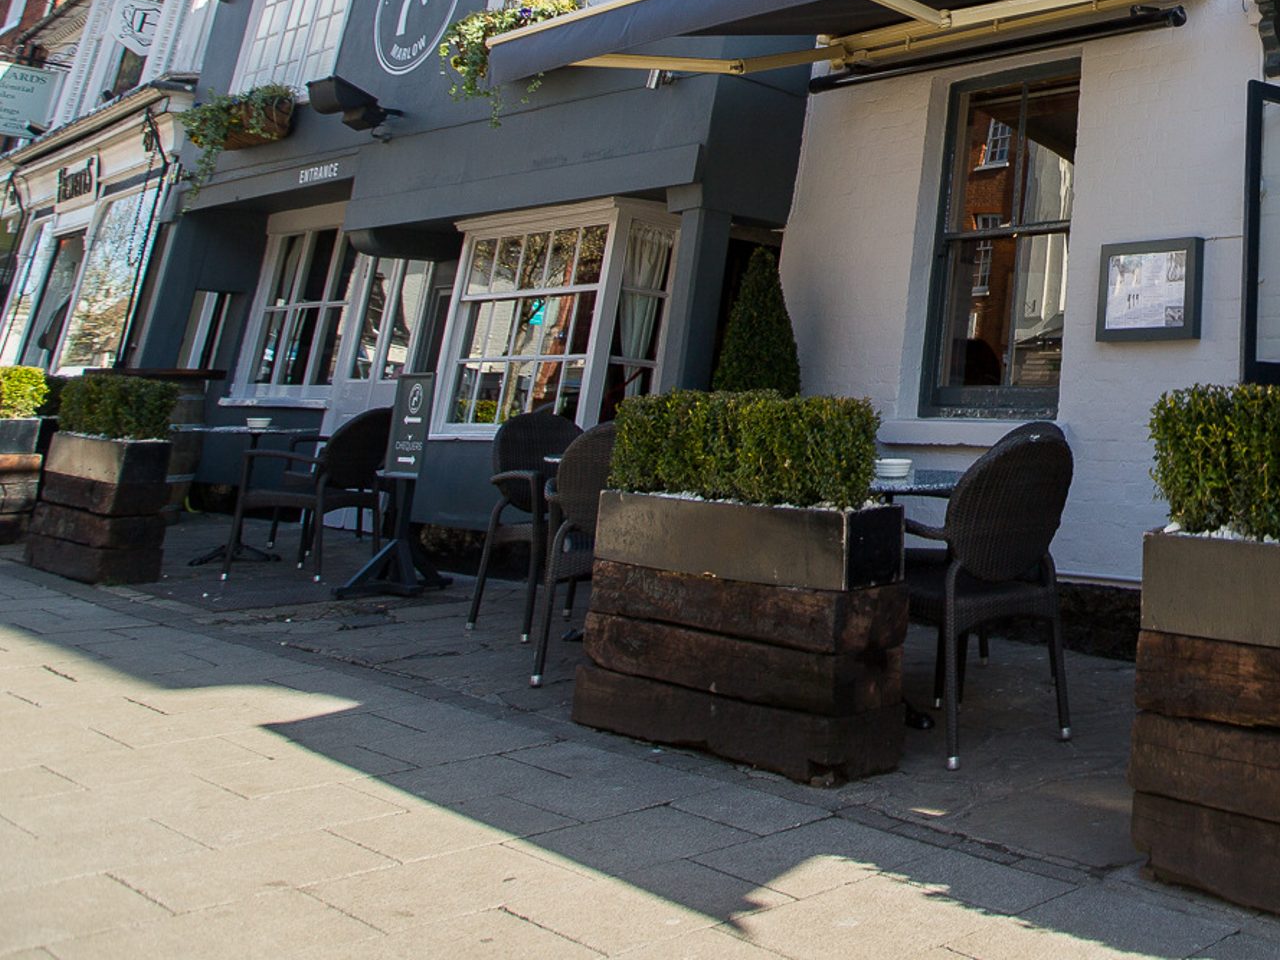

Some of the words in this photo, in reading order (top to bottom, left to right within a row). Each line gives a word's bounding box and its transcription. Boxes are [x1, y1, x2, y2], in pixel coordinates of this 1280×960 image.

[390, 34, 426, 61] MARLOW
[299, 162, 339, 184] ENTRANCE
[395, 441, 423, 452] CHEQUERS
